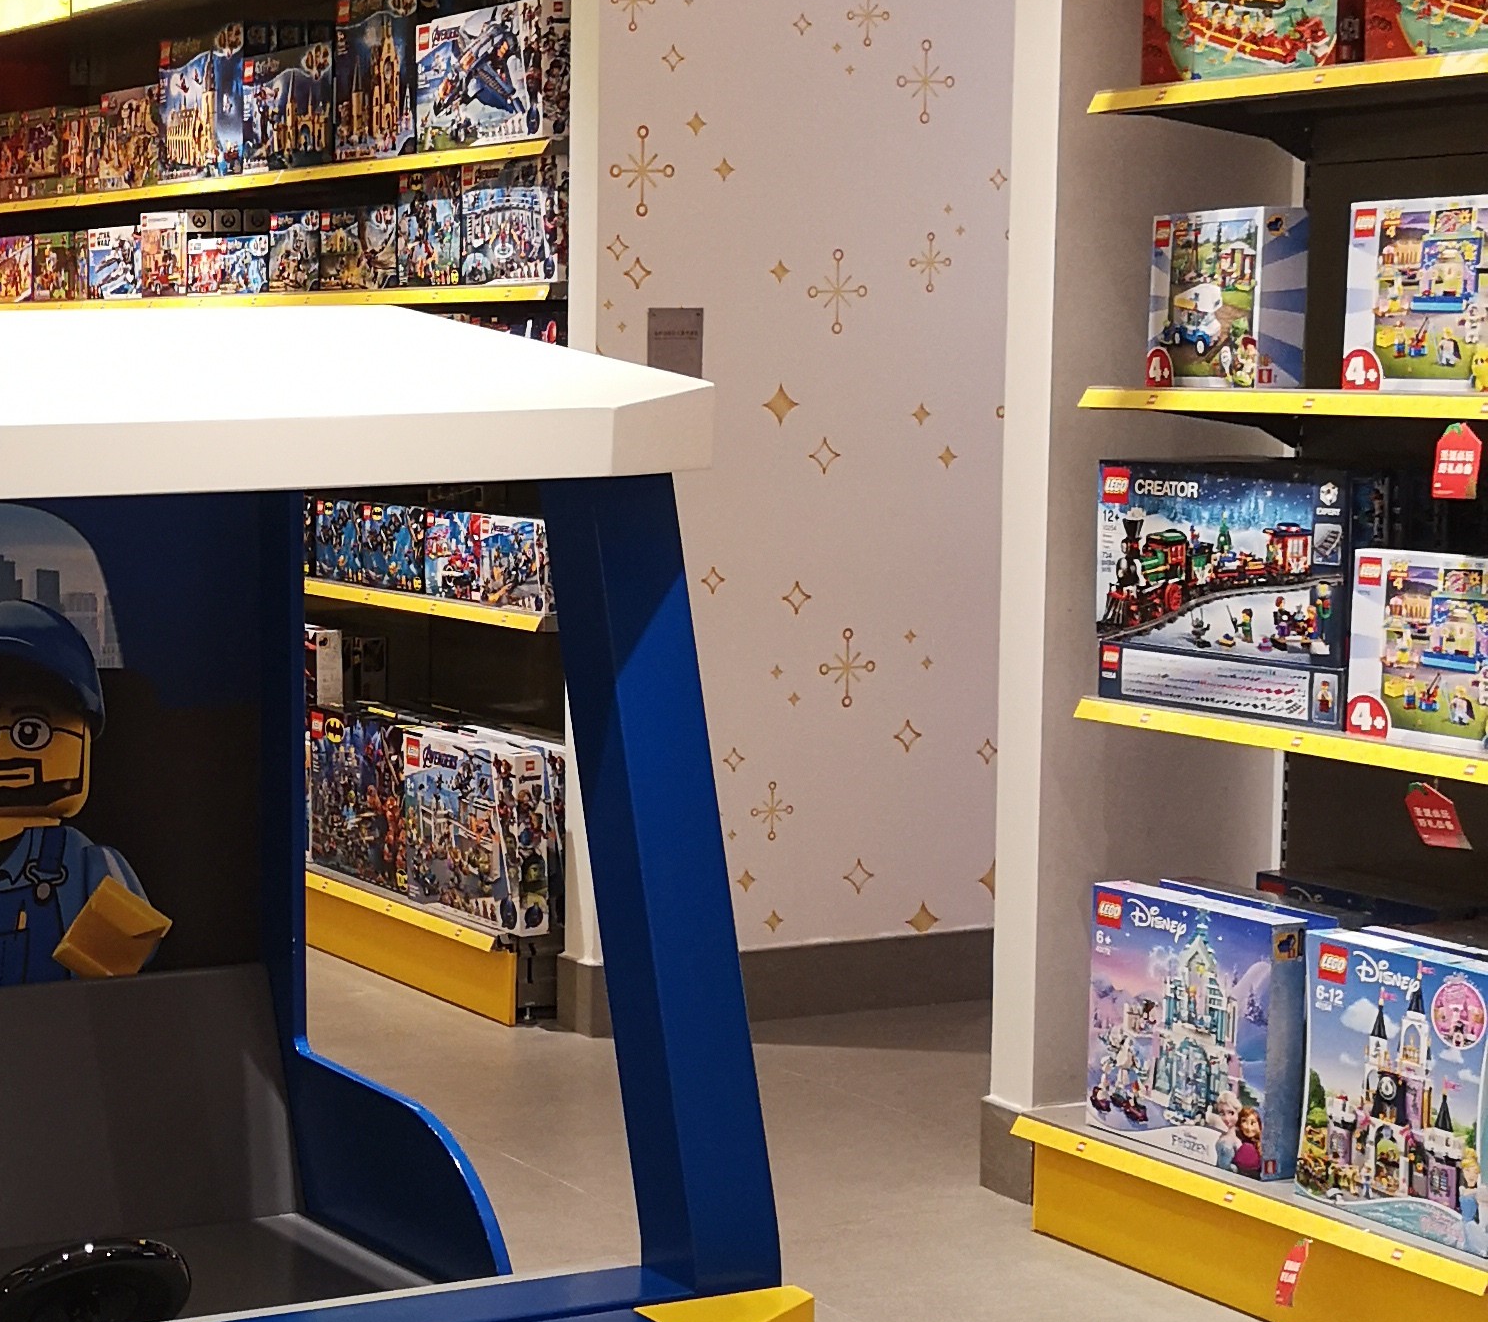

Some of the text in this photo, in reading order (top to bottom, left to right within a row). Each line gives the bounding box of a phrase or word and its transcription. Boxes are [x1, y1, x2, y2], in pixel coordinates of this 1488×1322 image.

[1148, 356, 1170, 382] 4+
[1345, 356, 1378, 385] 4+
[1104, 476, 1200, 499] LEGO CREATOR
[1103, 509, 1120, 522] 12+
[1350, 701, 1386, 731] 4+
[1097, 900, 1122, 920] LEGO
[1095, 929, 1112, 945] 6+
[1319, 953, 1348, 974] LEGO
[1315, 984, 1345, 1005] 6-12
